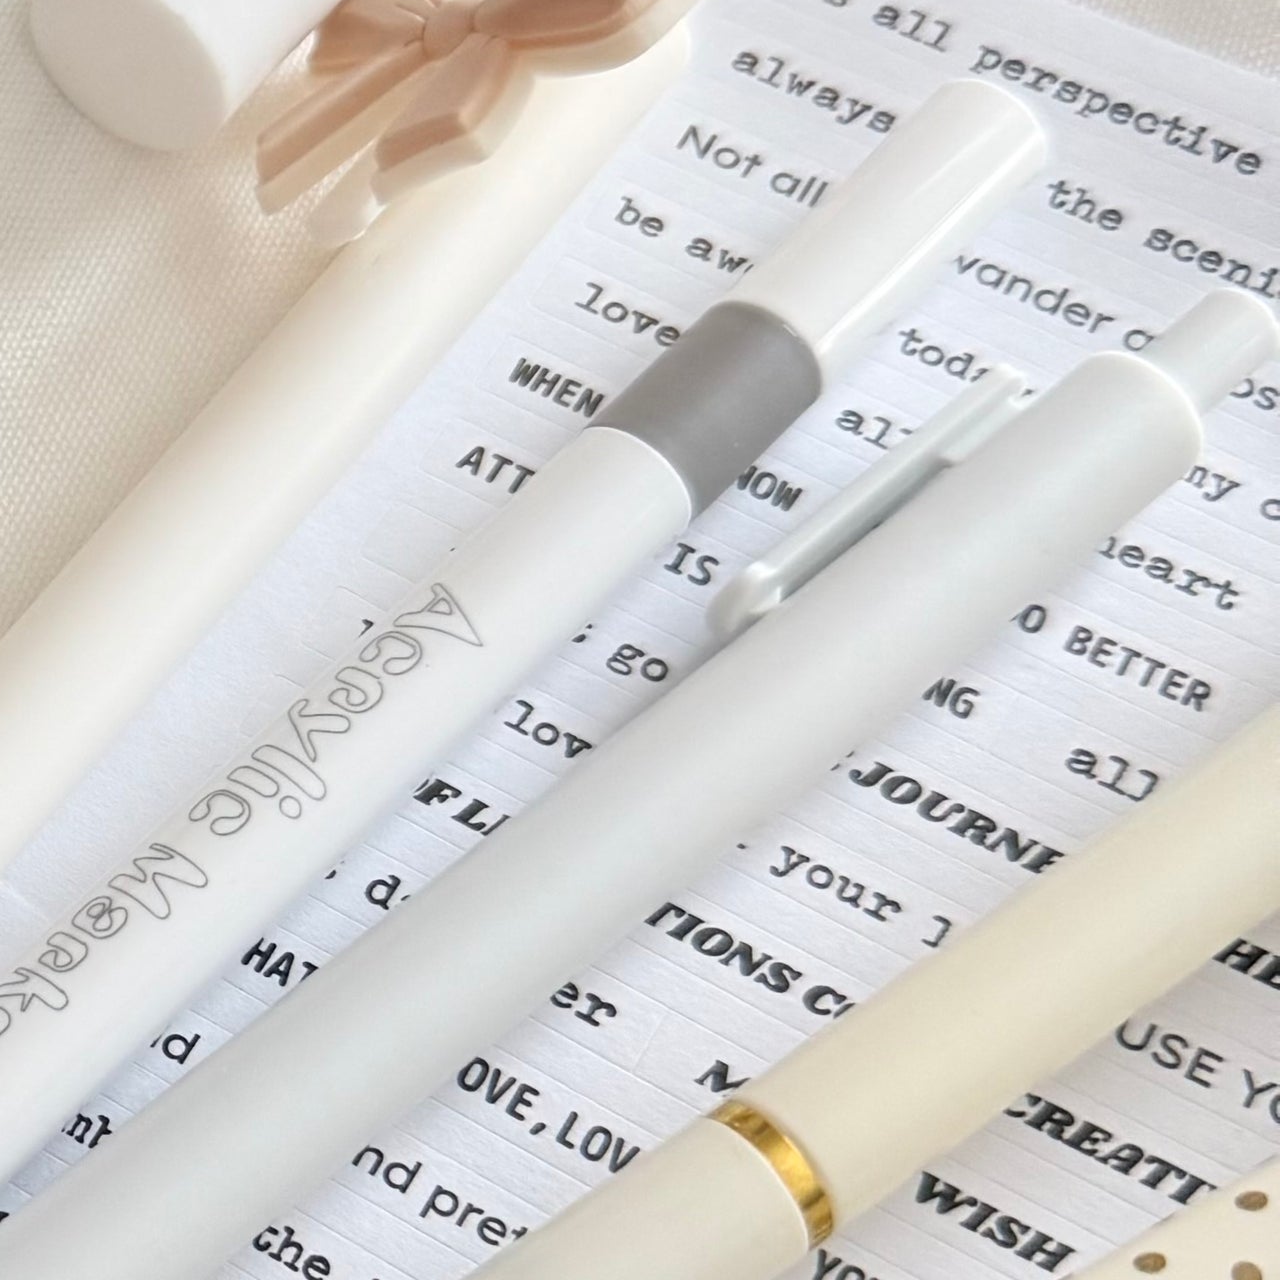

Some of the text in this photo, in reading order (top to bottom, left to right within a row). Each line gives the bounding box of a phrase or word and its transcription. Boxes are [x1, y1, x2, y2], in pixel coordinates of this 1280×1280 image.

[732, 49, 897, 135] always
[1047, 180, 1124, 231] the
[872, 4, 955, 53] all
[970, 43, 1264, 178] perspective
[676, 125, 764, 180] Not
[769, 169, 829, 208] all
[613, 196, 665, 239] be
[685, 236, 756, 276] aw
[574, 281, 682, 349] love
[454, 444, 538, 495] ATT
[663, 541, 721, 587] IS
[508, 356, 606, 419] WHEN
[1062, 625, 1213, 713] BETTER
[188, 581, 485, 838] Acrylic
[605, 641, 671, 684] go
[768, 845, 903, 923] your
[914, 1169, 1078, 1274] WISH
